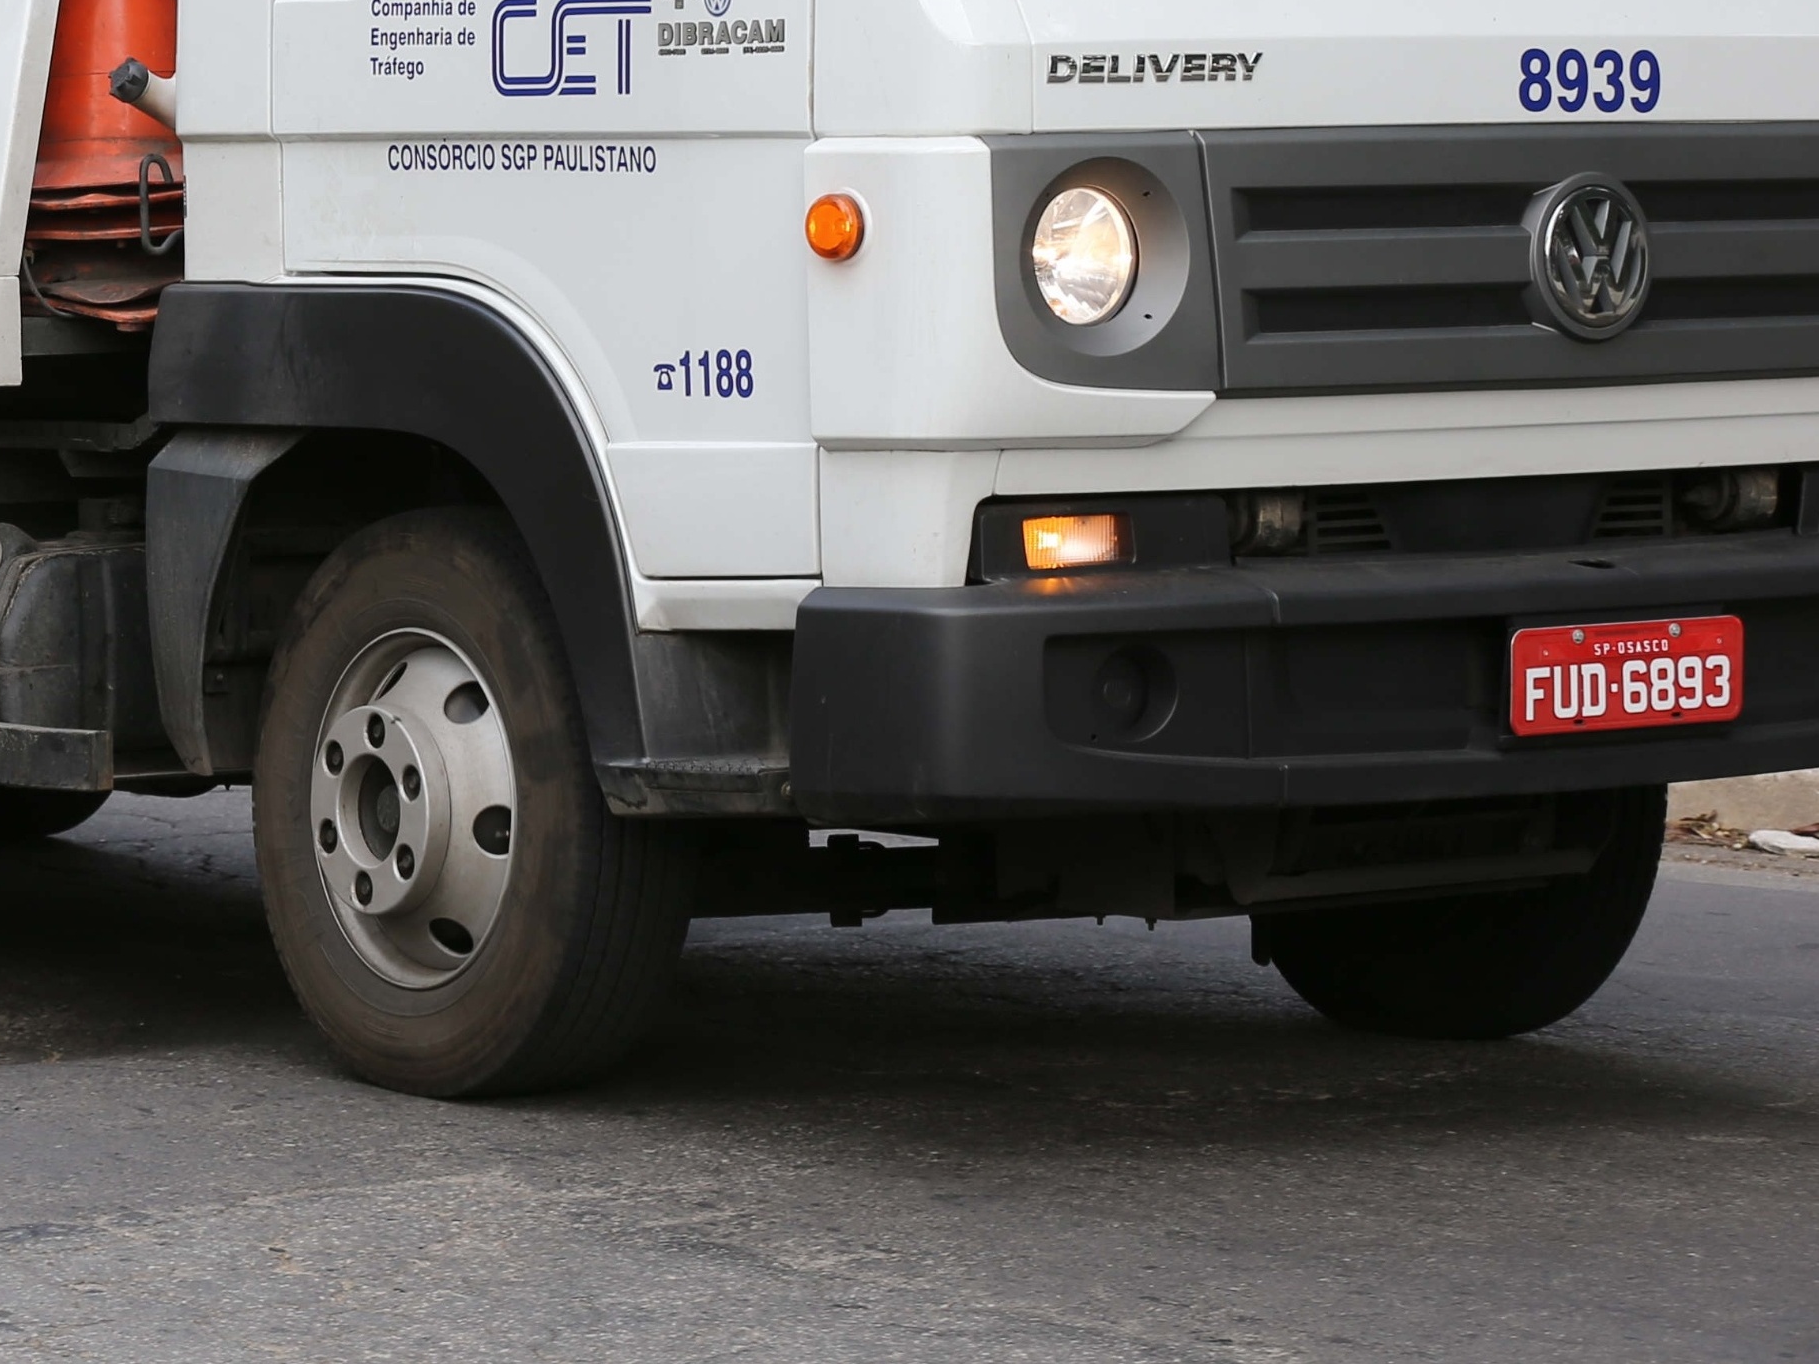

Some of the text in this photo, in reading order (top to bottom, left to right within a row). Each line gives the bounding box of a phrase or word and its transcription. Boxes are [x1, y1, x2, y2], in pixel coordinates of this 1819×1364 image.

[370, 27, 476, 50] Engenharia de
[658, 19, 785, 47] DIBRACAM
[370, 56, 424, 80] Tráfego
[1046, 52, 1263, 84] DELIVERY
[1519, 48, 1661, 113] 8939
[501, 144, 537, 171] SGP
[543, 145, 657, 173] PAULISTANO
[679, 349, 754, 398] 1188
